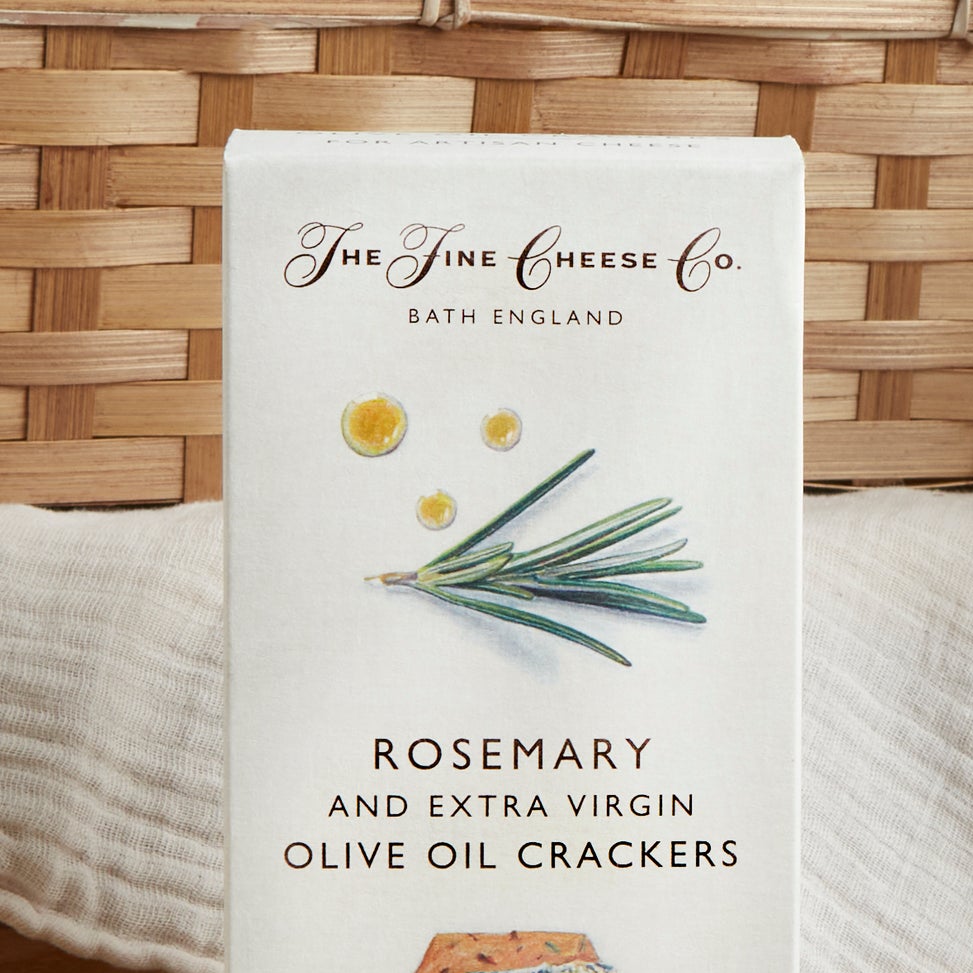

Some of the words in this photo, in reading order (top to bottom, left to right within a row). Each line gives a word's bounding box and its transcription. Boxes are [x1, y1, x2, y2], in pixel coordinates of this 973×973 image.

[408, 308, 476, 325] BATH
[494, 309, 624, 326] ENGLAND
[373, 738, 652, 770] ROSEMARY
[328, 795, 408, 817] AND
[429, 795, 548, 817] EXTRA
[567, 794, 694, 816] VIRGIN
[284, 841, 404, 869] OLIVE
[428, 841, 496, 869] OIL
[518, 840, 738, 868] CRACKERS
